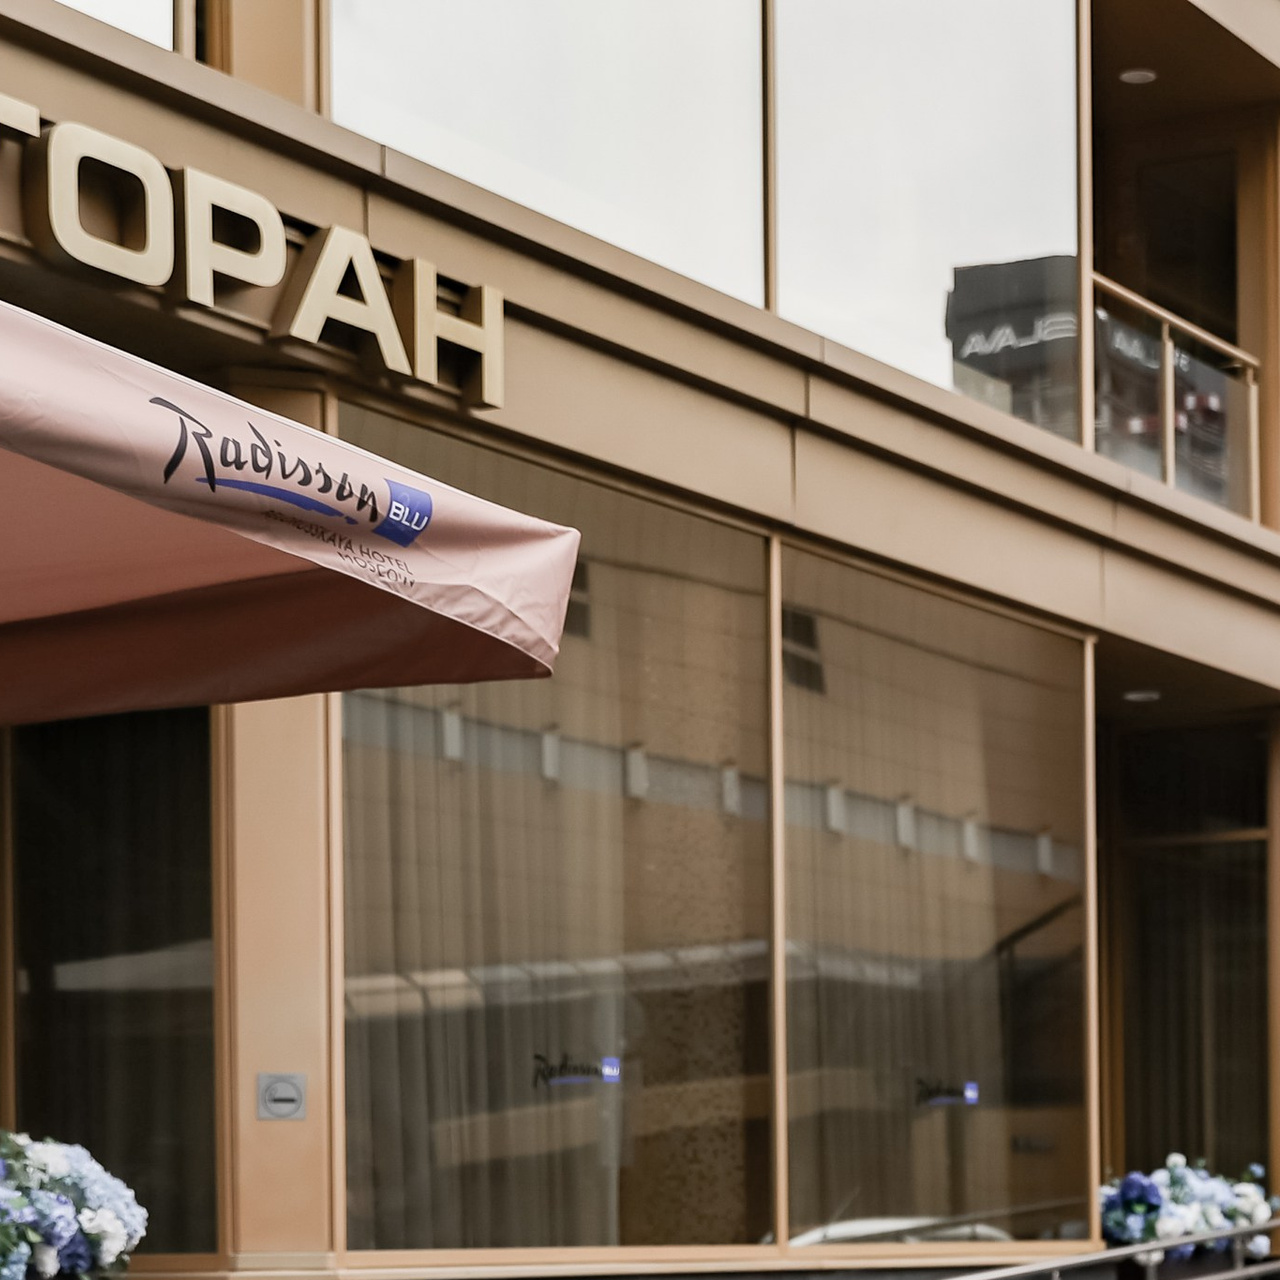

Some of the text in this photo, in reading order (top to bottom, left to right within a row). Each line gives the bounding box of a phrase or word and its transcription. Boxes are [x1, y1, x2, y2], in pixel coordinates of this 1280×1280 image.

[149, 397, 428, 531] Radisson BLU
[359, 543, 414, 575] HOTEL
